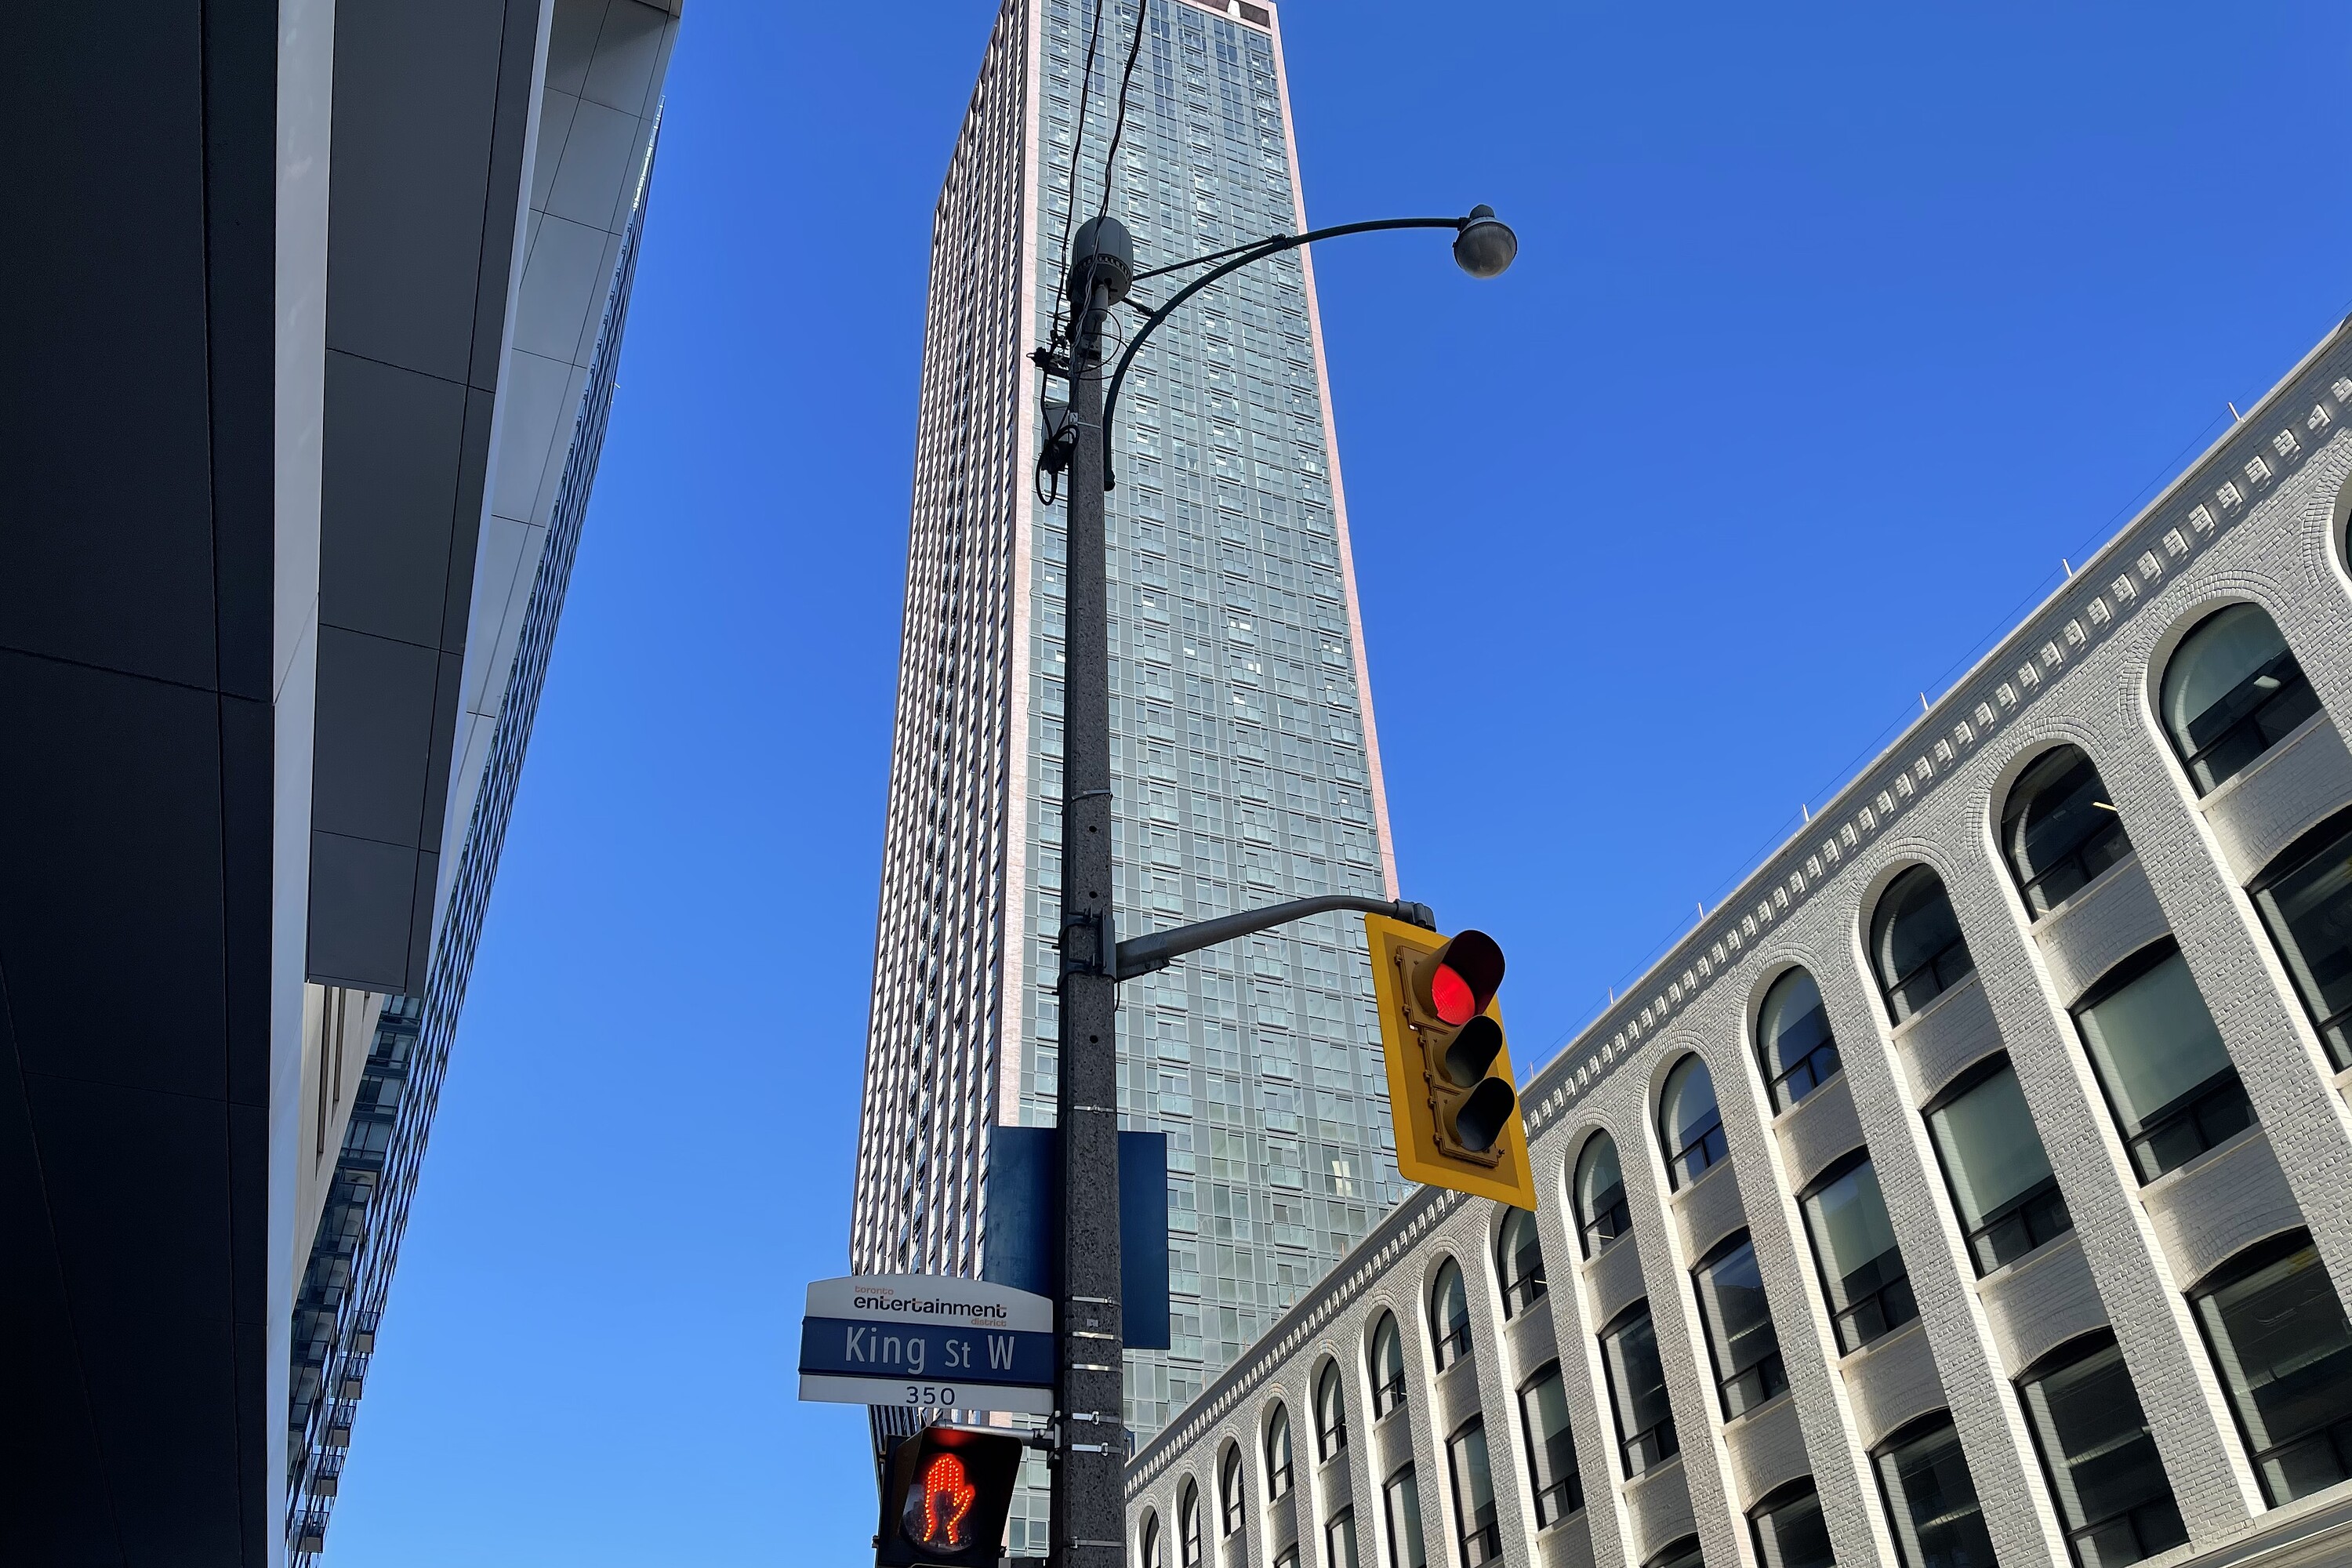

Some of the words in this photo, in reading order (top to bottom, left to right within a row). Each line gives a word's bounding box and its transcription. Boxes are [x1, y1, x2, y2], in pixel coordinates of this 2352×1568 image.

[855, 1285, 894, 1295] toronto
[854, 1295, 1007, 1318] entertainment
[971, 1318, 1007, 1327] district
[845, 1327, 926, 1374] King
[945, 1339, 971, 1368] St
[988, 1335, 1015, 1370] W
[906, 1386, 956, 1406] 350
